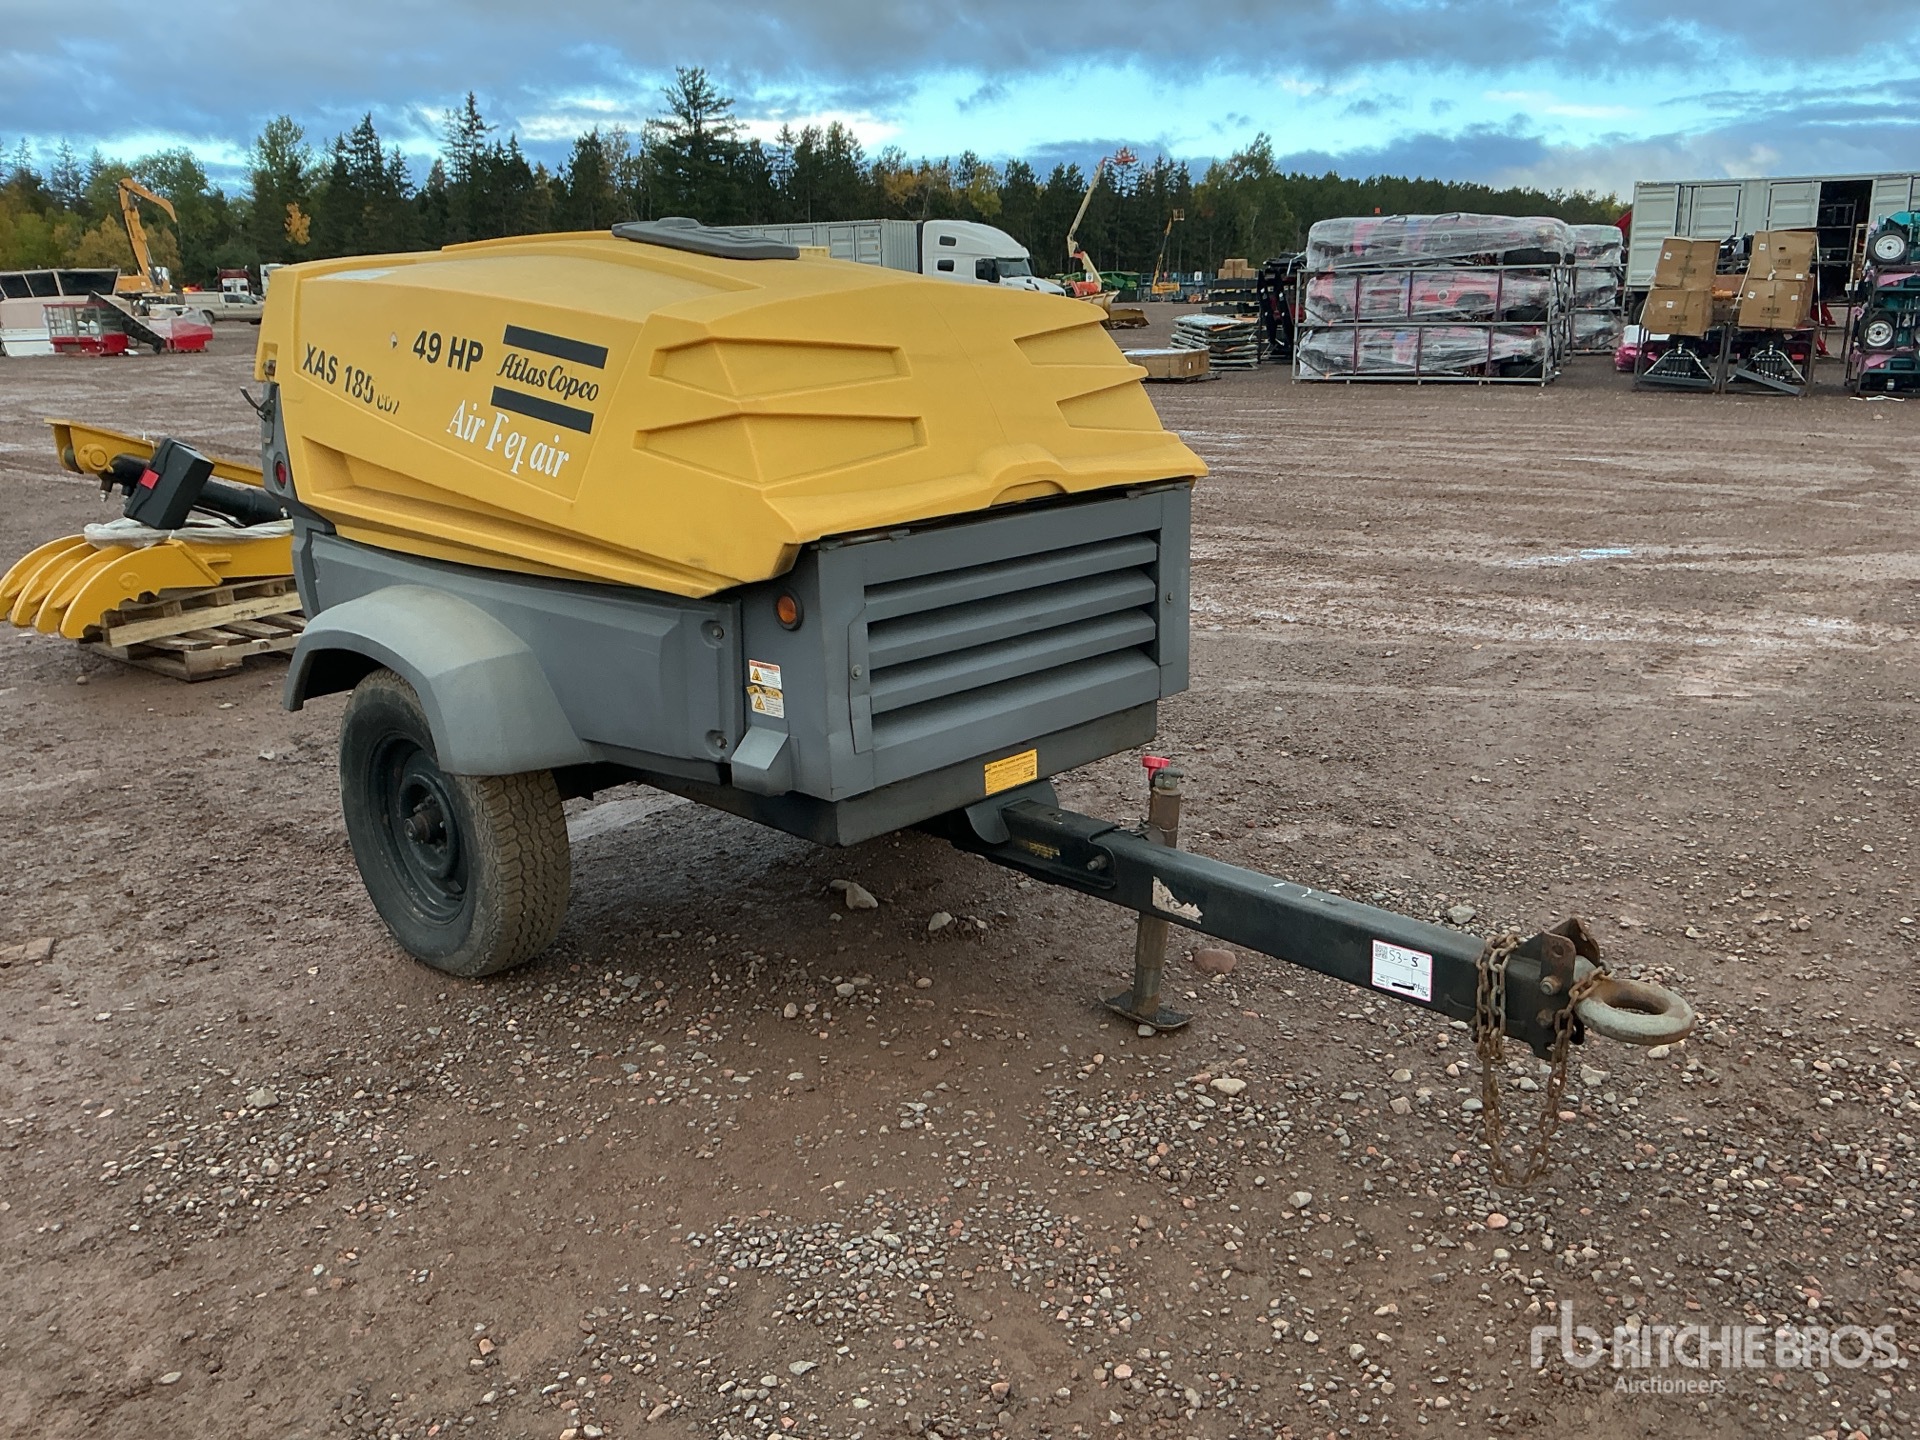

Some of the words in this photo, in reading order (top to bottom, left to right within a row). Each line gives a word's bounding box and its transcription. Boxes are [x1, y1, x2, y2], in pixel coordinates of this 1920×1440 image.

[302, 341, 339, 385] XAS
[344, 364, 375, 404] 185
[412, 330, 442, 364] 49
[447, 335, 484, 373] HP
[496, 352, 547, 388] Atlas
[547, 364, 600, 402] Copco
[445, 399, 486, 444] Air
